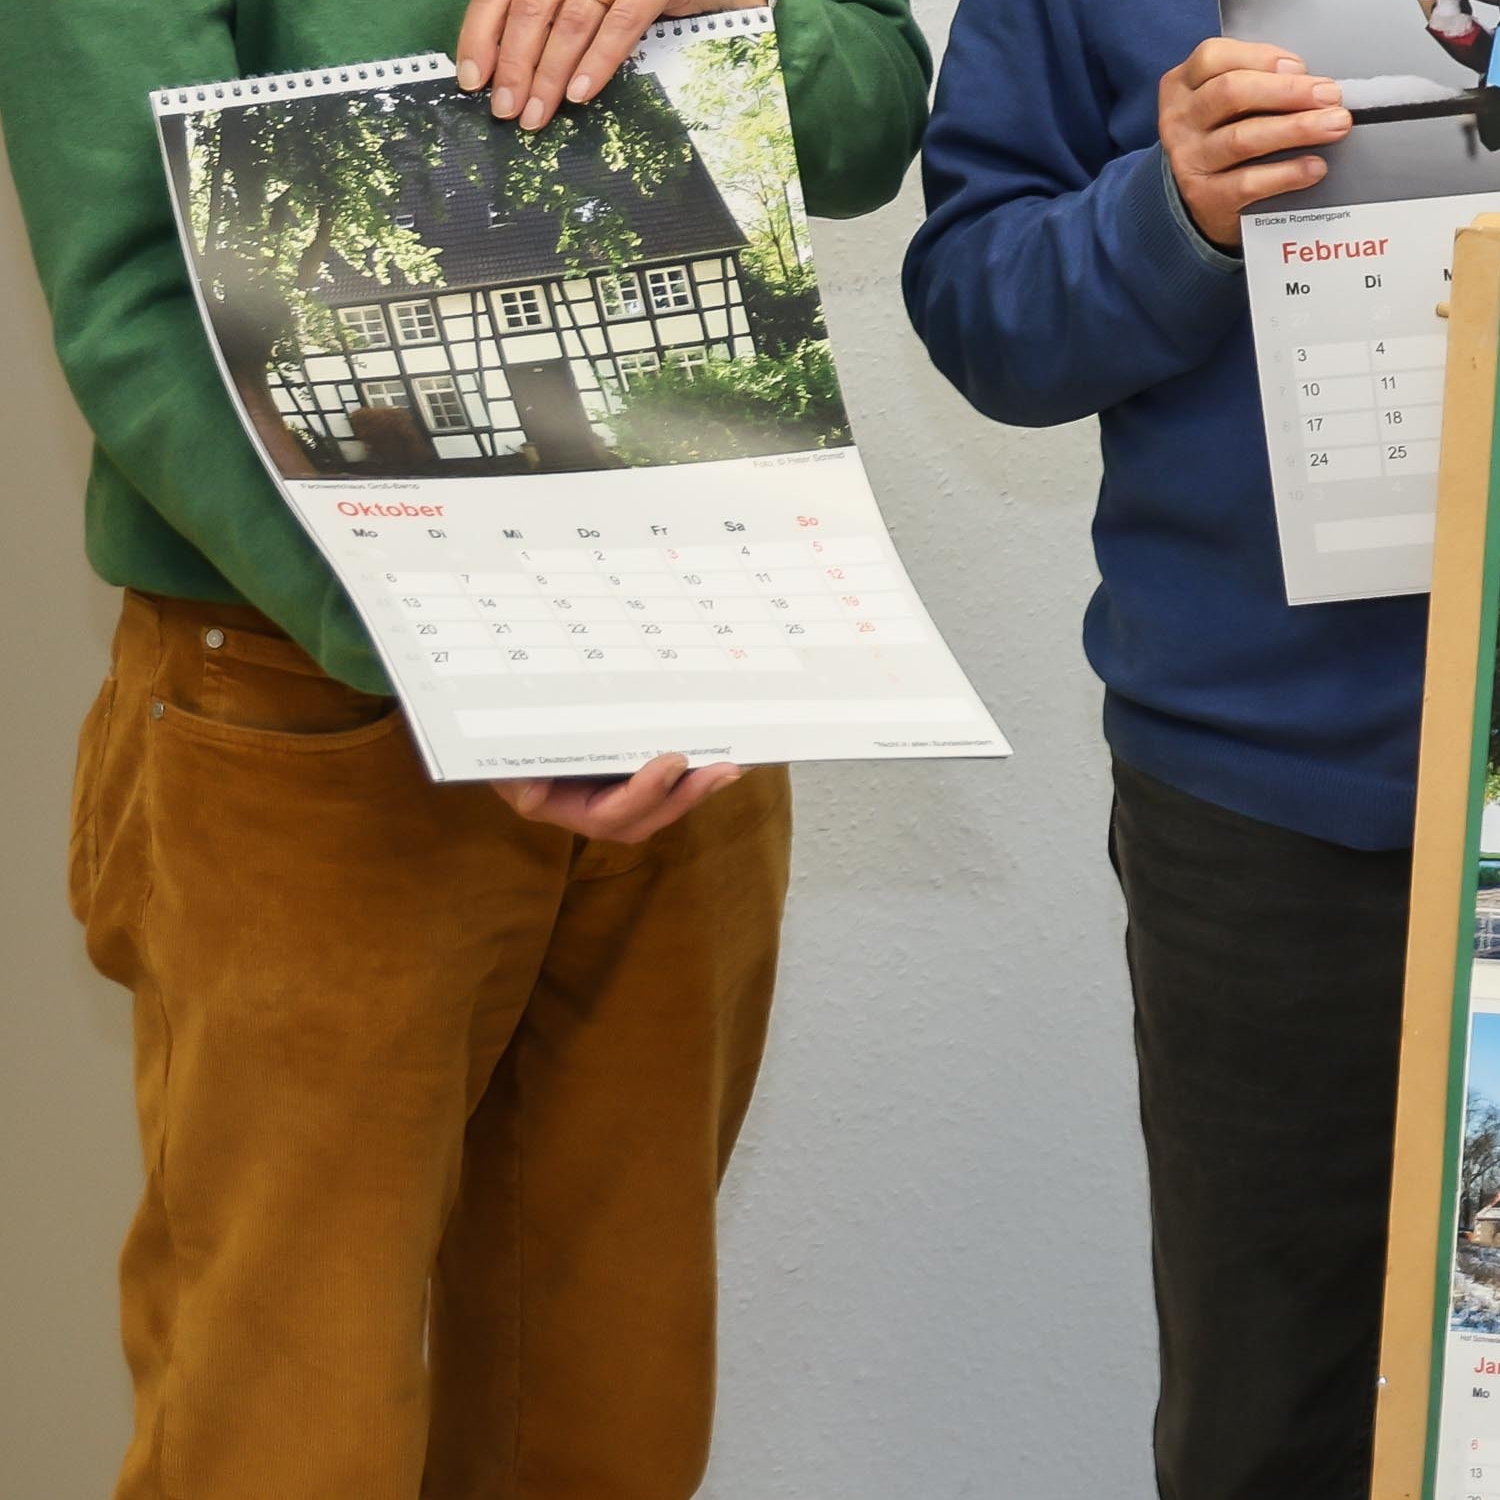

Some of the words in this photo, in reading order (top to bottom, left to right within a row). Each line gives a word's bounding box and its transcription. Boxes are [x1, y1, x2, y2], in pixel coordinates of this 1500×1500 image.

[1255, 216, 1286, 227] Brücke
[1289, 210, 1351, 224] Rombergpark
[1282, 239, 1388, 263] Februar
[1286, 282, 1310, 295] Mo
[1365, 275, 1381, 288] Di
[1297, 349, 1307, 362] 3
[1376, 342, 1385, 354] 4
[1302, 383, 1320, 396] 10
[1381, 376, 1395, 389] 11
[1307, 418, 1323, 431] 17
[1385, 411, 1402, 424] 18
[1311, 453, 1328, 466] 24
[1388, 446, 1407, 459] 25
[337, 502, 443, 517] Oktober
[352, 529, 378, 537] Mo
[427, 529, 446, 538] Di
[502, 530, 523, 538] Mi
[577, 528, 600, 538] Do
[651, 525, 667, 535] Fr
[724, 521, 745, 532] Sa
[797, 516, 818, 527] So
[1473, 1388, 1490, 1398] Mo
